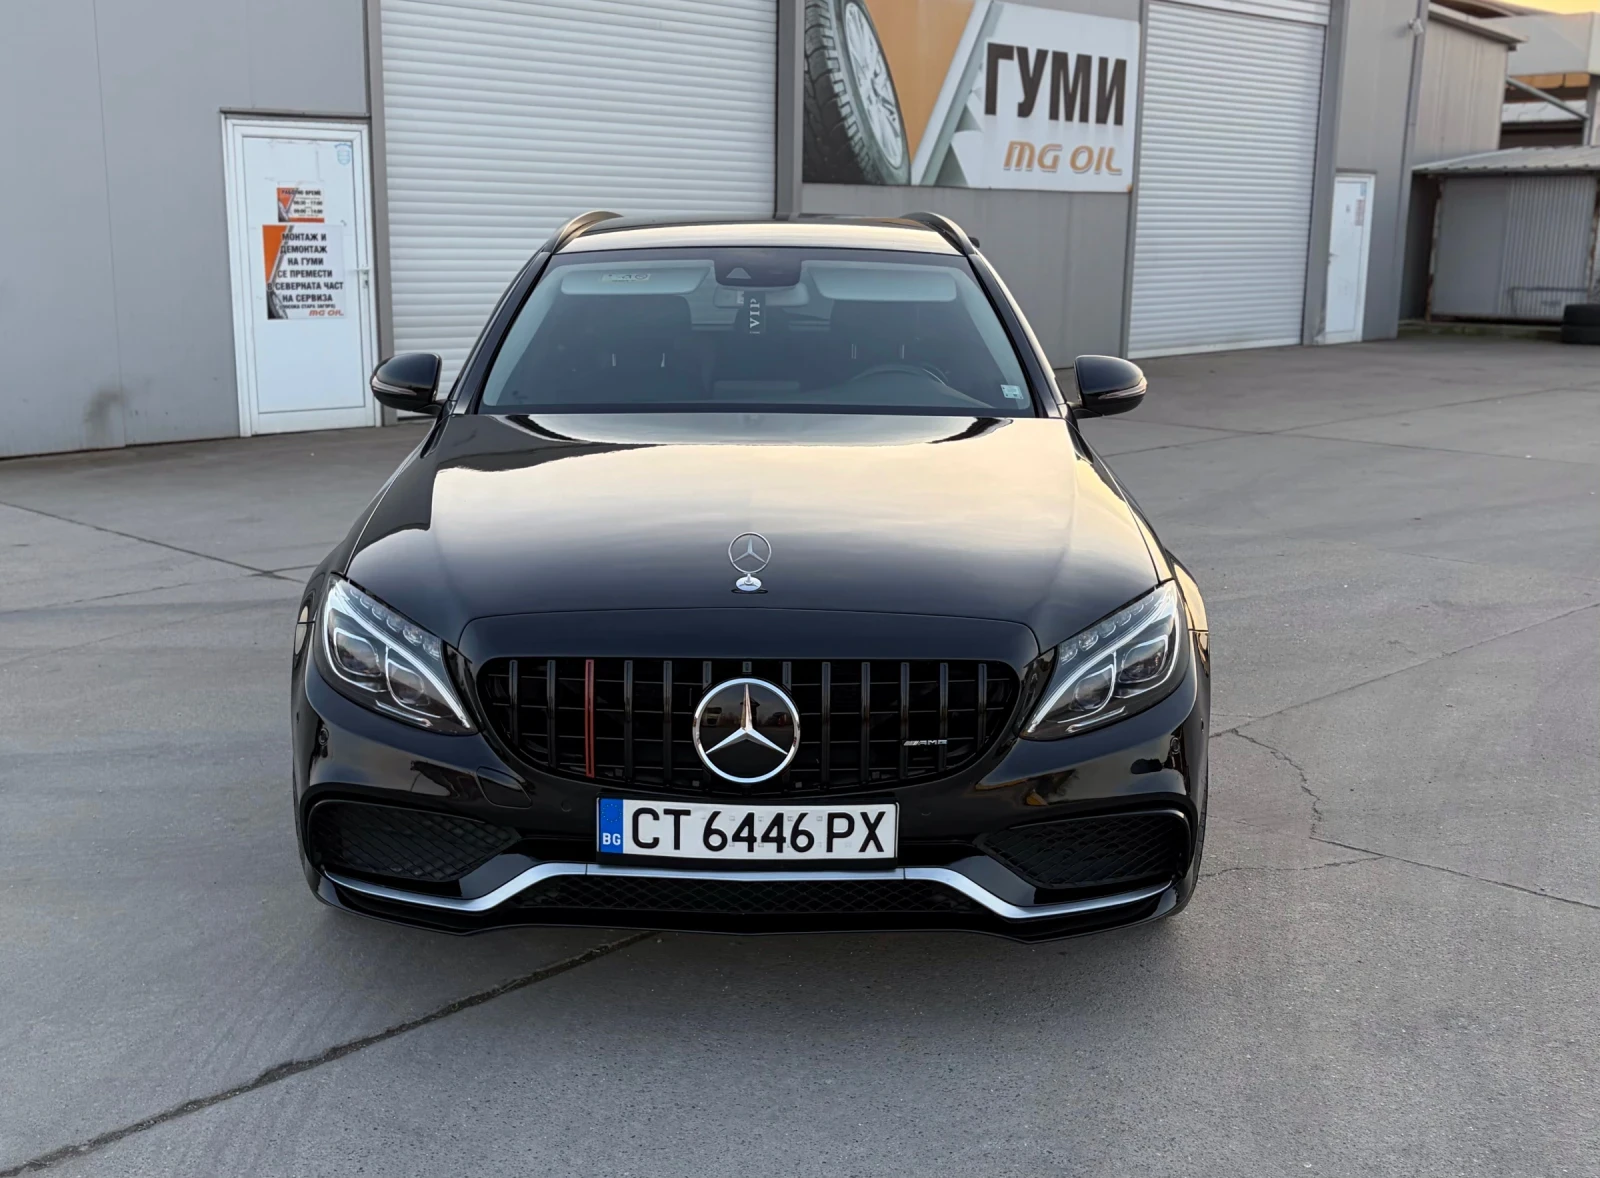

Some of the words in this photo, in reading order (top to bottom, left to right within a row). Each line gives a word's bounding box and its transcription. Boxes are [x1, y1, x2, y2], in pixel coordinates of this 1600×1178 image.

[984, 42, 1127, 126] ГУМИ
[1003, 140, 1063, 172] MG
[1069, 145, 1123, 176] OIL
[282, 233, 319, 241] МОНТАЖ
[321, 233, 327, 241] И
[280, 245, 328, 254] ДЕМОНТАЖ
[287, 257, 299, 266] НА
[301, 257, 324, 266] ГУМИ
[277, 270, 288, 278] СЕ
[290, 270, 333, 278] ПРЕМЕСТИ
[267, 282, 274, 291] В
[275, 282, 322, 291] СЕВЕРНАТА
[323, 281, 344, 290] ЧАСТ
[282, 294, 294, 303] НА
[295, 293, 333, 302] СЕРВИЗА
[631, 807, 692, 851] CT
[702, 810, 815, 853] 6446
[825, 811, 887, 853] PX
[602, 832, 621, 846] BG
